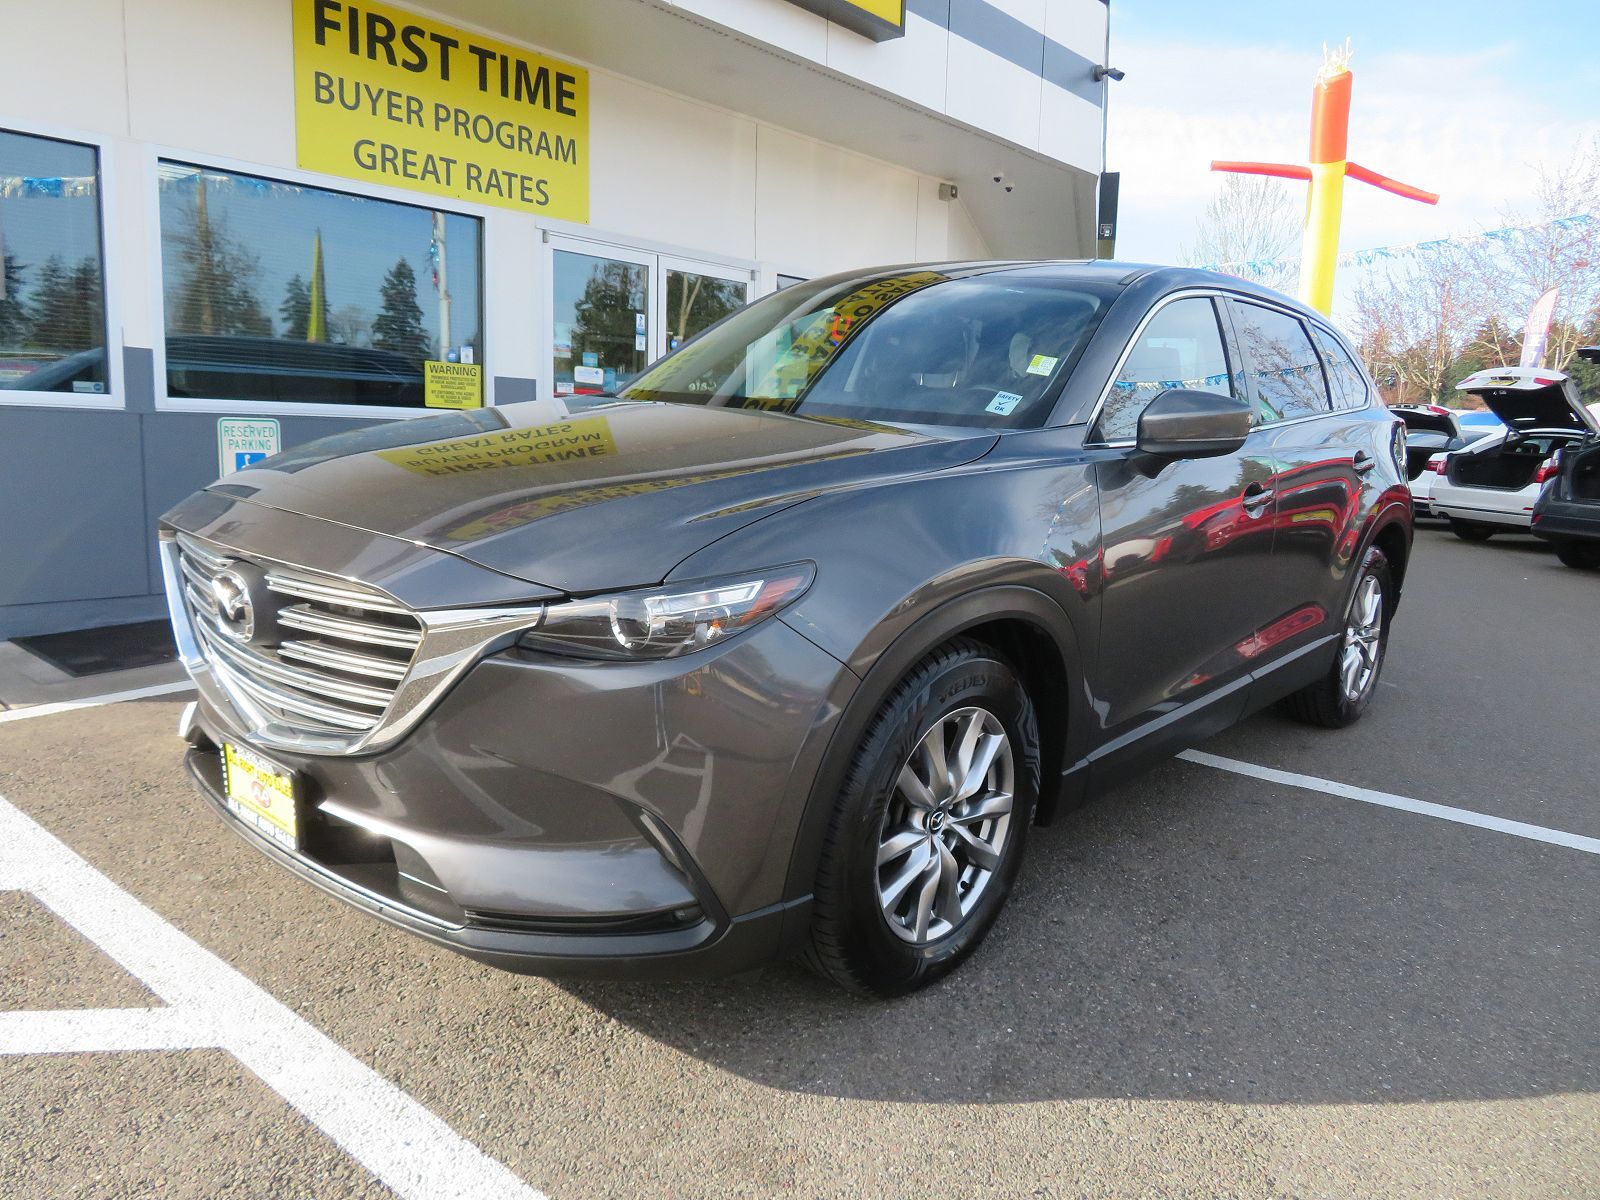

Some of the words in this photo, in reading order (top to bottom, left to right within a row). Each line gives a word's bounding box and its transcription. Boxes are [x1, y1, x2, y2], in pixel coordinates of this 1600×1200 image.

[314, 0, 459, 81] FIRST
[468, 44, 577, 118] TIME
[314, 71, 425, 129] BUYER
[434, 103, 577, 166] PROGRAM
[353, 138, 457, 187] GREAT
[466, 162, 550, 207] RATES
[429, 364, 477, 377] WARNING
[997, 393, 1021, 402] SAFETY
[223, 425, 275, 438] RESERVED
[228, 438, 272, 450] PARKING
